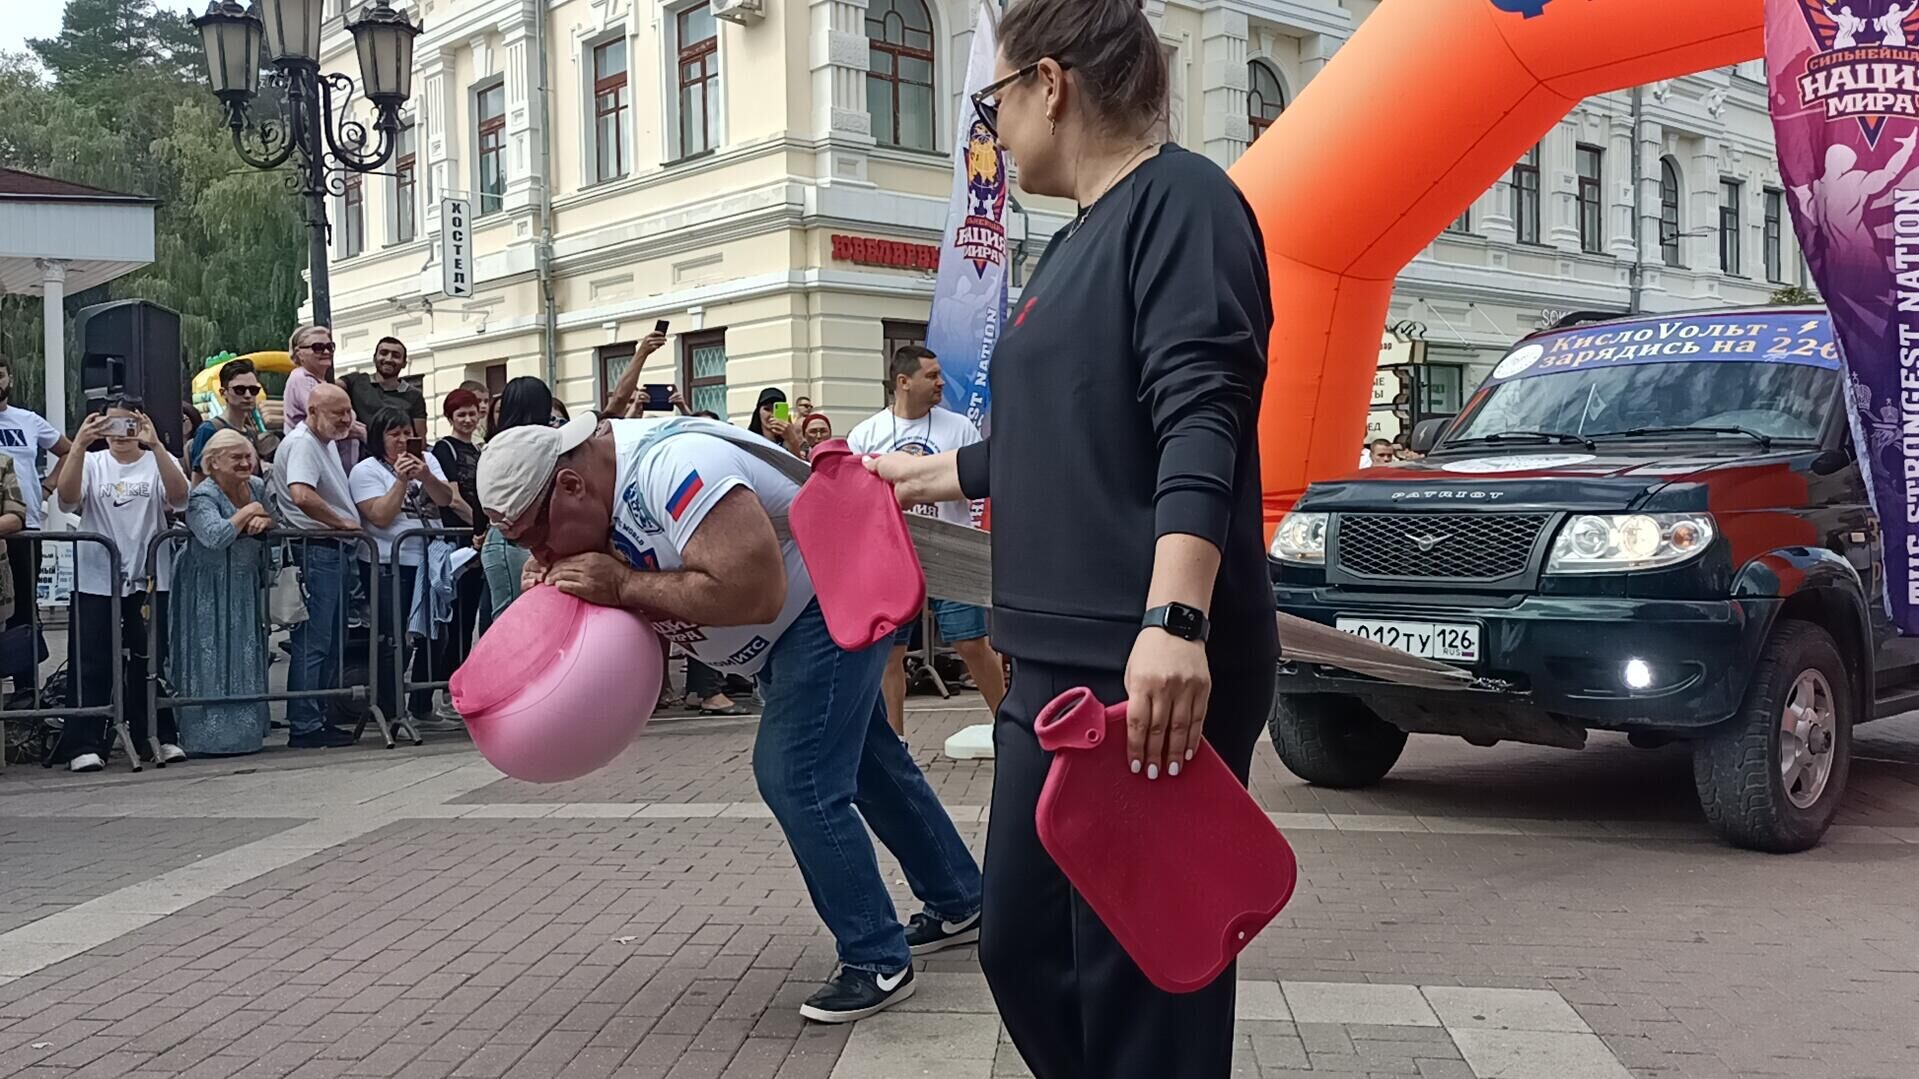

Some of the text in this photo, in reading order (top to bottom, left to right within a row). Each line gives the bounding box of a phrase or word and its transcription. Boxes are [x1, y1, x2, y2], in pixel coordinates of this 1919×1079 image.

[1801, 63, 1919, 102] НАЦИ
[1827, 93, 1916, 117] МИРА
[451, 202, 465, 284] ХОСТЕЛ
[1893, 188, 1919, 312] NATION
[976, 307, 997, 387] NATION
[1539, 341, 1700, 368] зарядись
[1709, 340, 1756, 353] на
[1392, 490, 1503, 499] PATRIOT
[622, 523, 645, 546] WORLD
[1344, 625, 1472, 653] 012ТУ 126
[1443, 648, 1461, 656] RUS
